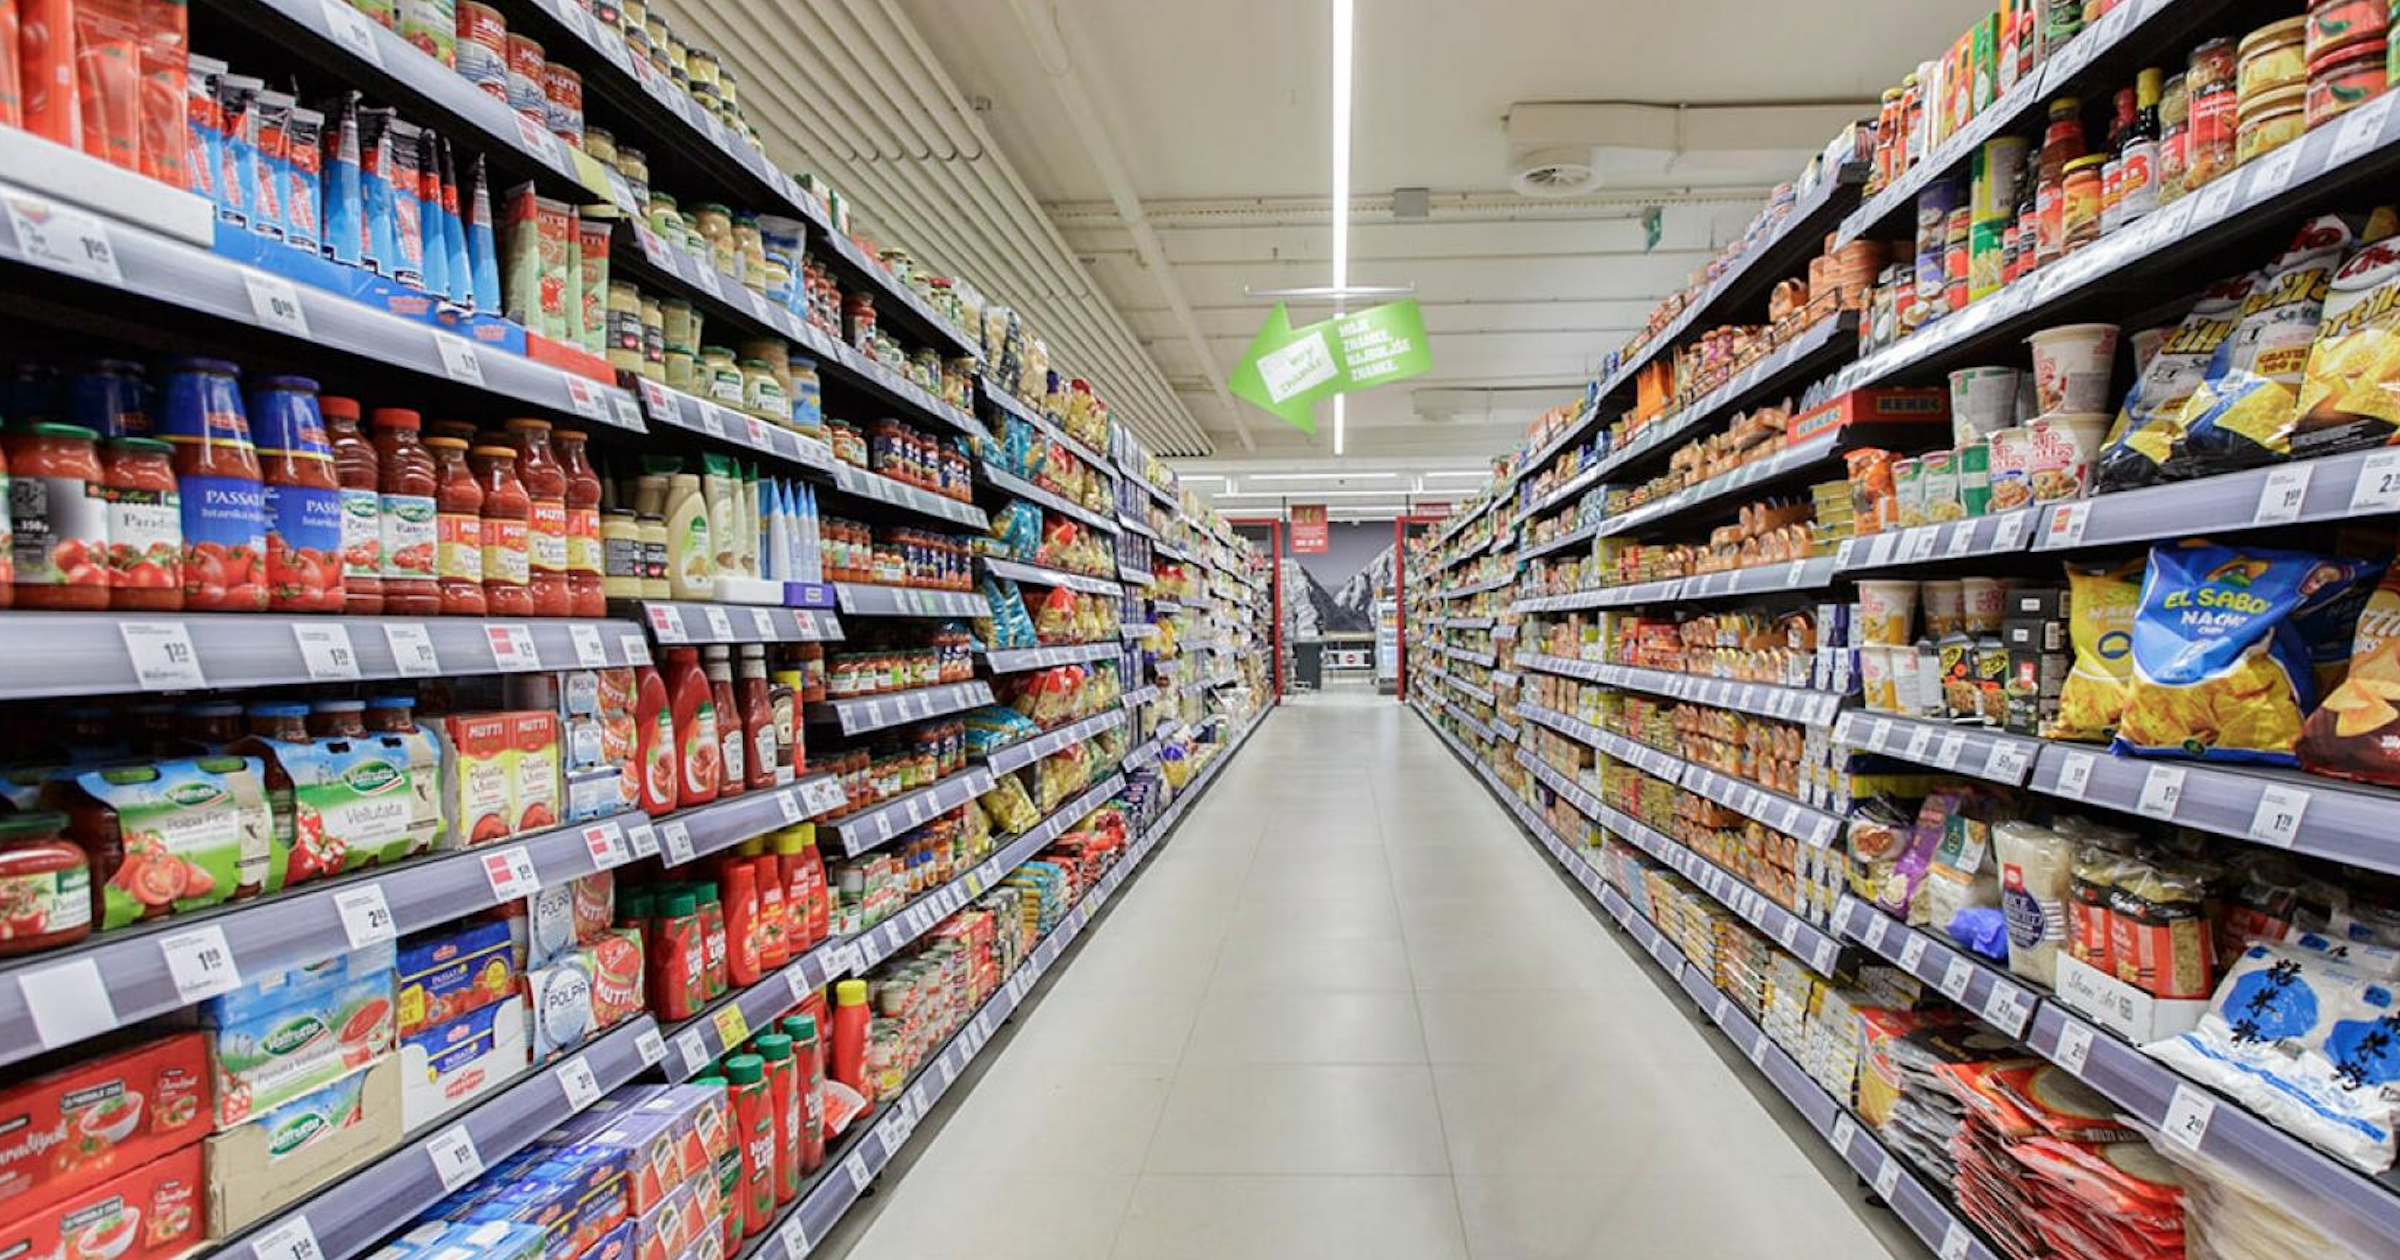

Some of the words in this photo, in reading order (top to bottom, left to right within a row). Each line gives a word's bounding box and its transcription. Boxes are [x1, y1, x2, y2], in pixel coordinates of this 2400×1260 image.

[2163, 590, 2192, 609] EL
[2197, 587, 2272, 614] SABO
[467, 723, 504, 739] MUTTI
[550, 981, 587, 1009] POLPA
